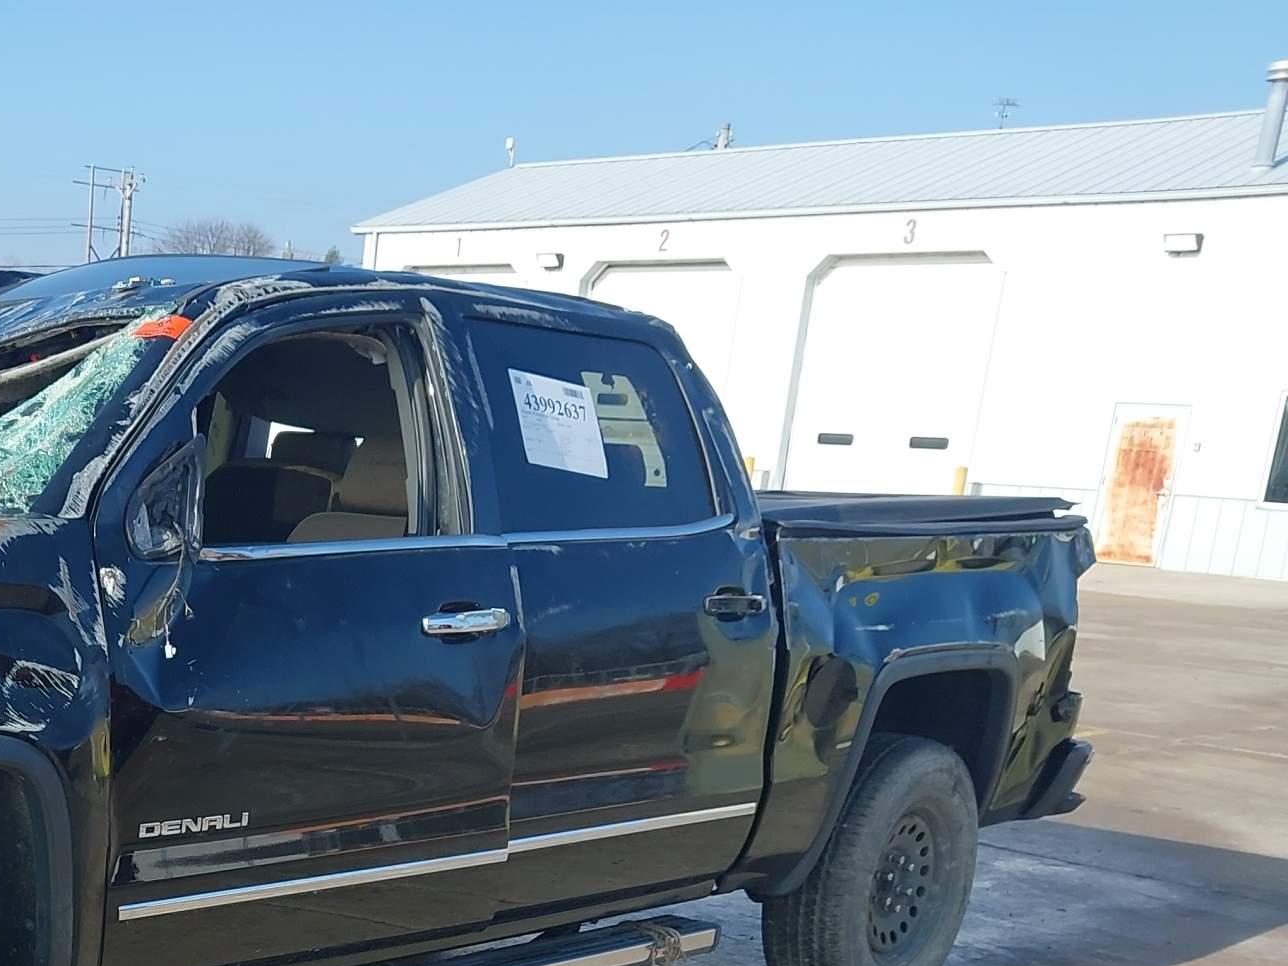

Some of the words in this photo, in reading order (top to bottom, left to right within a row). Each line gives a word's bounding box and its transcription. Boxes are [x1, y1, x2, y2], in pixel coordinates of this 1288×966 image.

[658, 229, 670, 251] 2
[903, 219, 917, 244] 3
[523, 392, 586, 422] 43992637
[138, 812, 249, 838] DENALI
